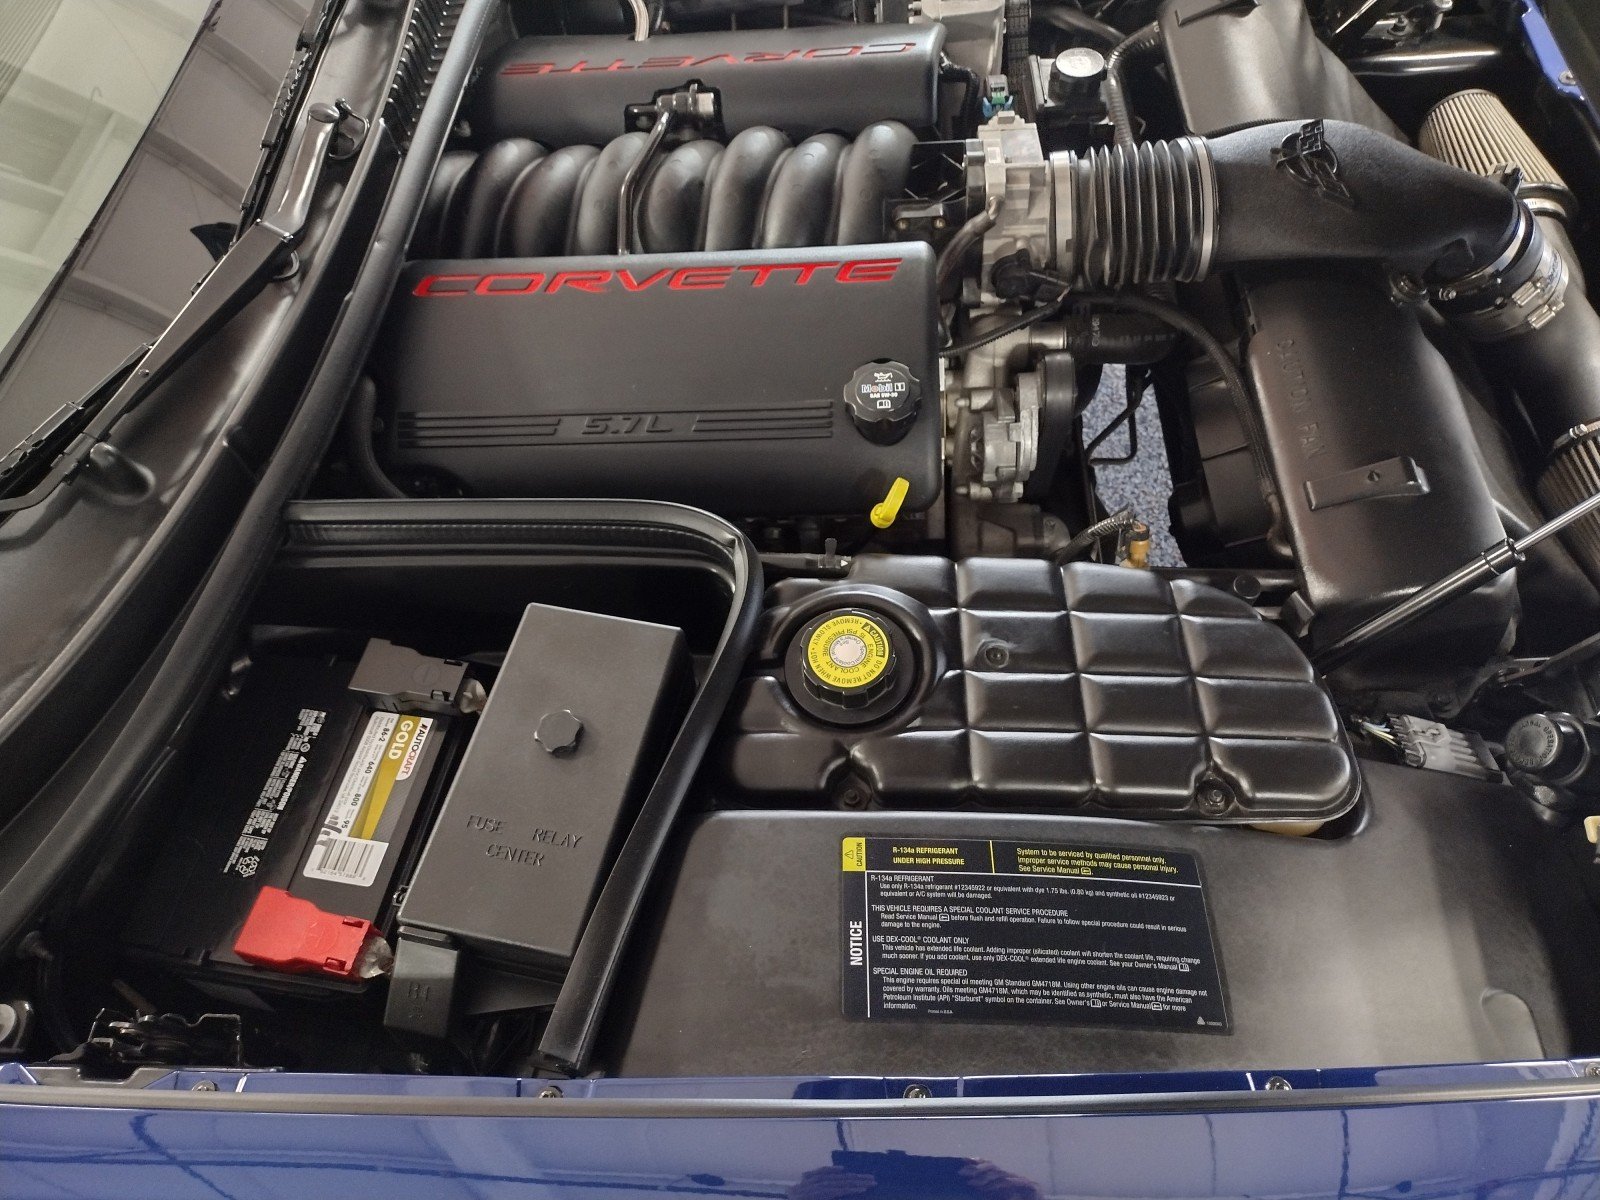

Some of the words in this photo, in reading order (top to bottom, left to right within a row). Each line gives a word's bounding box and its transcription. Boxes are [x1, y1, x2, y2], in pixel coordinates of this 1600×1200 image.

[501, 42, 916, 76] CORVETTE
[412, 258, 902, 297] CORVETTE
[861, 383, 893, 393] Mobil
[582, 416, 673, 435] 5.7L
[833, 618, 859, 626] REMOVE
[814, 624, 831, 646] SLOWLY
[823, 629, 845, 656] PRESSURE
[869, 630, 884, 657] CAUTION
[863, 644, 874, 668] ENGINE
[815, 663, 832, 679] WHEN
[826, 661, 860, 673] COOLANT
[874, 660, 883, 669] DO
[833, 676, 862, 684] REMOVE
[863, 669, 875, 680] NOT
[379, 728, 390, 742] 86-2
[388, 719, 414, 759] GOLD
[402, 728, 426, 775] AUTOCRAFT
[365, 761, 374, 774] 640
[351, 793, 361, 806] 800
[341, 820, 350, 829] 95
[467, 815, 507, 834] FUSE
[532, 828, 582, 848] RELAY
[486, 844, 545, 866] CENTER
[893, 846, 914, 854] R-134a
[915, 847, 958, 855] REFRIGERANT
[1016, 848, 1039, 857] System
[1057, 850, 1084, 859] serviced
[1093, 852, 1120, 862] qualified
[1121, 854, 1151, 864] personnel
[931, 857, 965, 865] PRESSURE
[1018, 856, 1045, 867] Improper
[1046, 858, 1069, 866] service
[1070, 859, 1097, 868] methods
[1098, 862, 1112, 870] may
[1132, 863, 1158, 873] personal
[1031, 865, 1055, 873] Service
[1056, 866, 1079, 874] Manual
[975, 906, 1003, 914] COOLANT
[1005, 907, 1030, 915] SERVICE
[1031, 908, 1068, 916] PROCEDURE
[881, 921, 903, 929] damage
[850, 920, 863, 966] NOTICE
[872, 935, 884, 943] USE
[985, 946, 1005, 954] Adding
[1006, 947, 1031, 955] improper
[873, 967, 898, 975] SPECIAL
[895, 977, 915, 985] engine
[915, 978, 939, 986] requires
[940, 978, 960, 986] special
[969, 979, 992, 987] meeting
[953, 986, 977, 995] meeting
